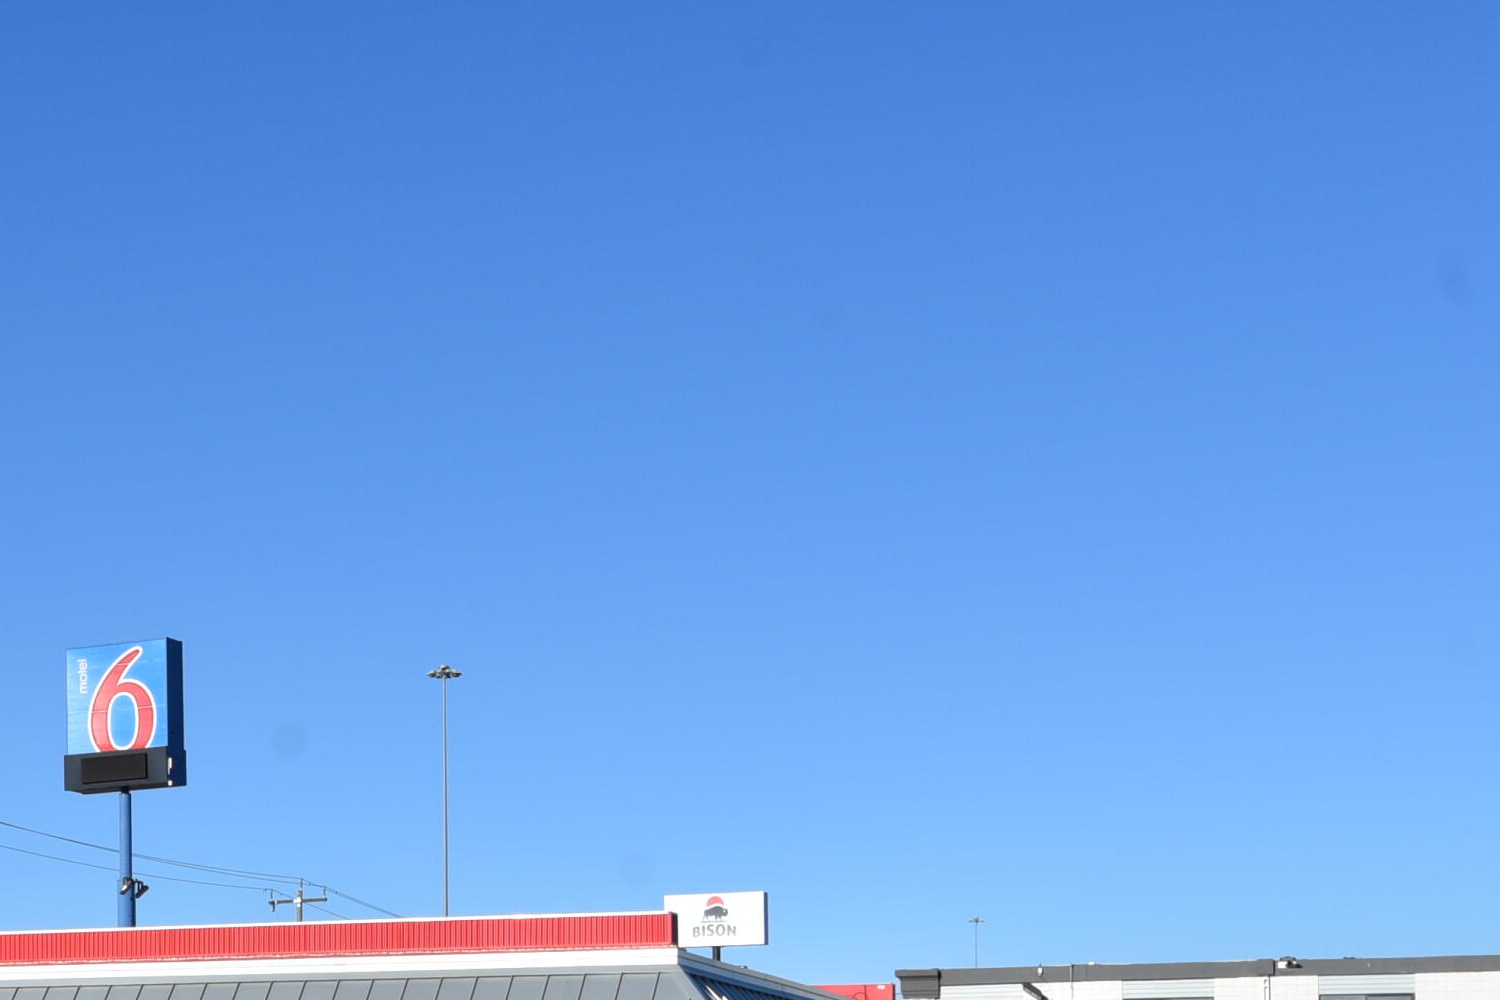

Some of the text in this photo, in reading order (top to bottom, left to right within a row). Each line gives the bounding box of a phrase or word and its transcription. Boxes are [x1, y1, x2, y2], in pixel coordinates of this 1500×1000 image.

[77, 659, 88, 694] motel
[88, 646, 156, 752] 6
[692, 924, 736, 937] BISON
